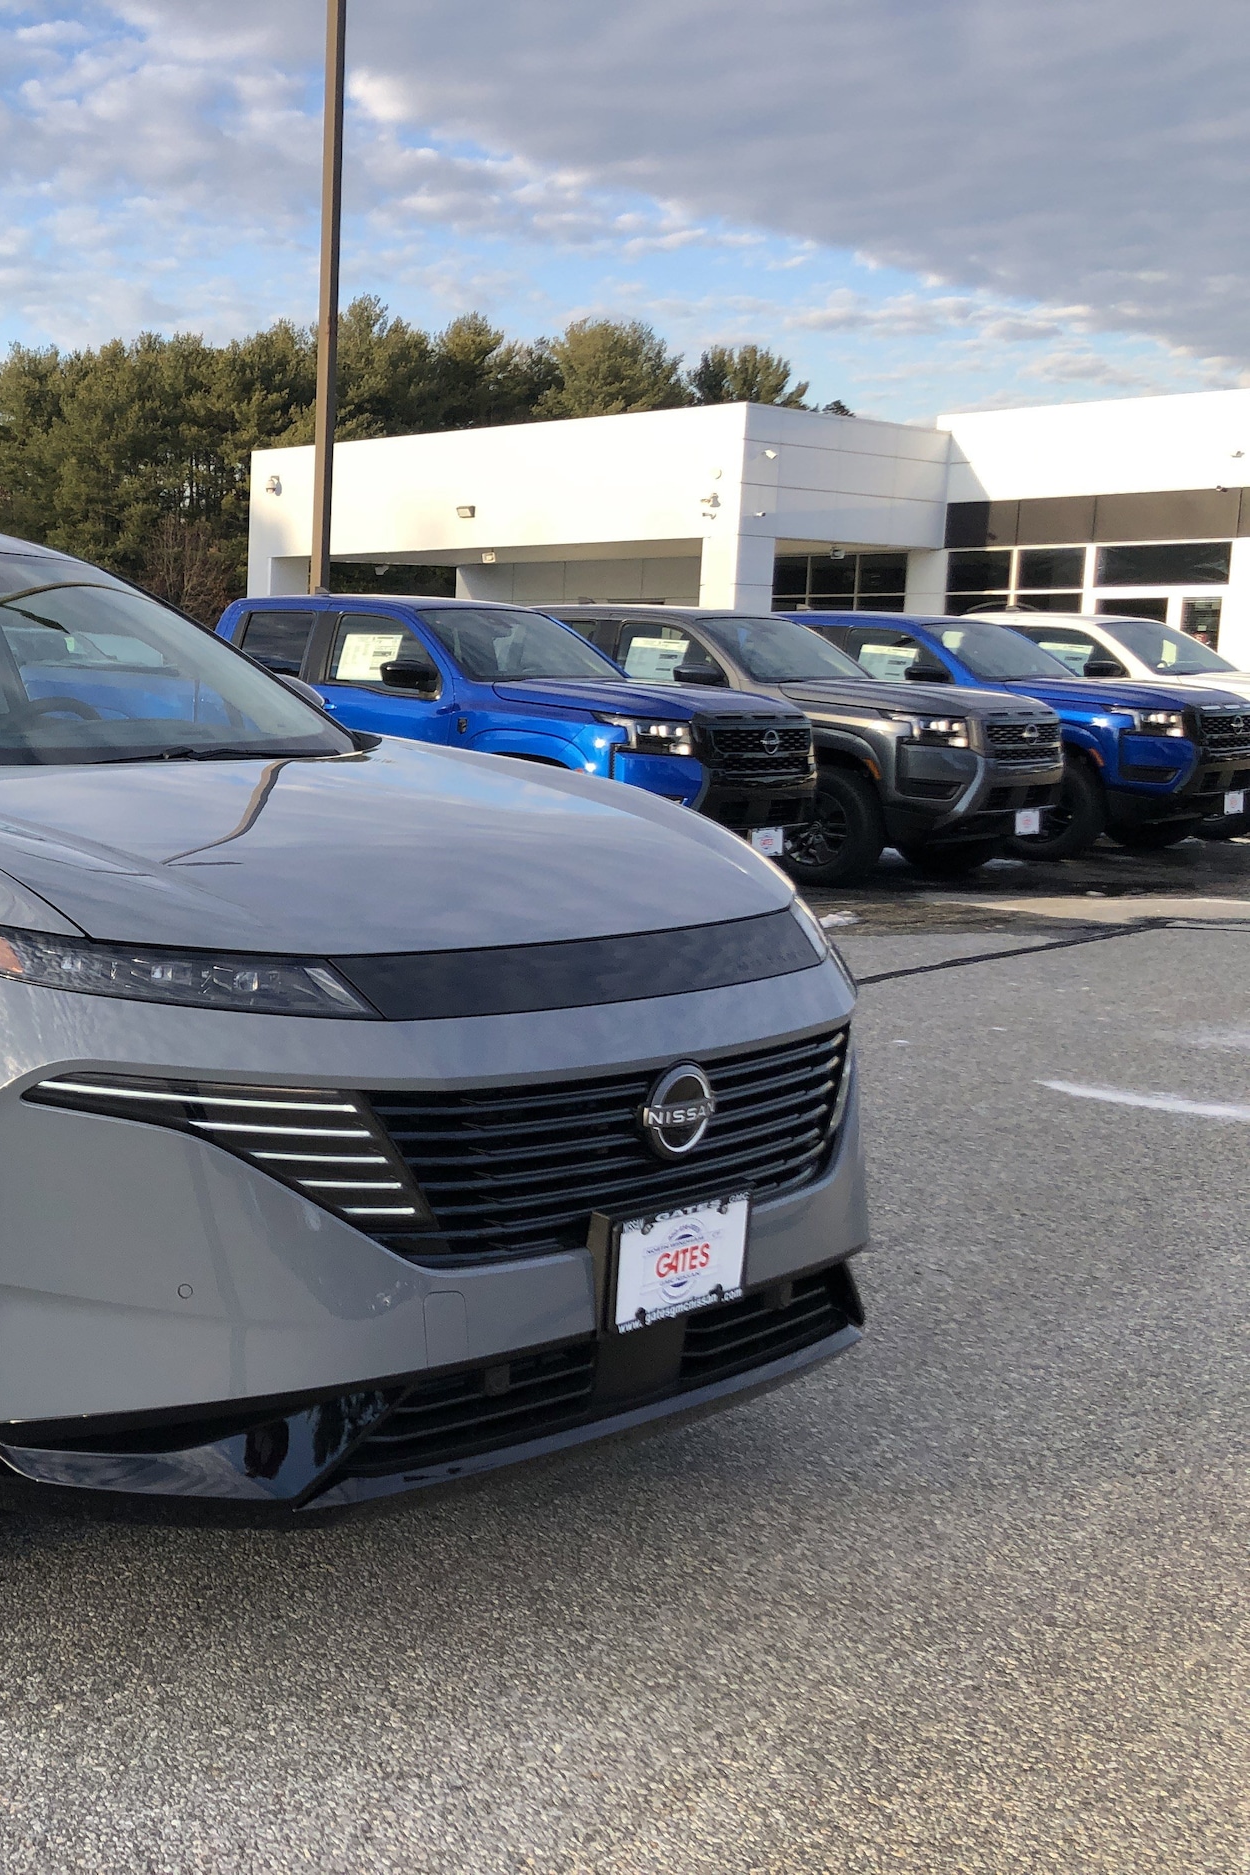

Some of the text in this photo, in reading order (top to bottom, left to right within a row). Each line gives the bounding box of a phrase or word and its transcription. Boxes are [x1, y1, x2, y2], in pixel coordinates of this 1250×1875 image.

[648, 1096, 716, 1125] NISSAN
[654, 1199, 722, 1222] GATES
[729, 1191, 750, 1204] GMC
[655, 1242, 710, 1278] GATES
